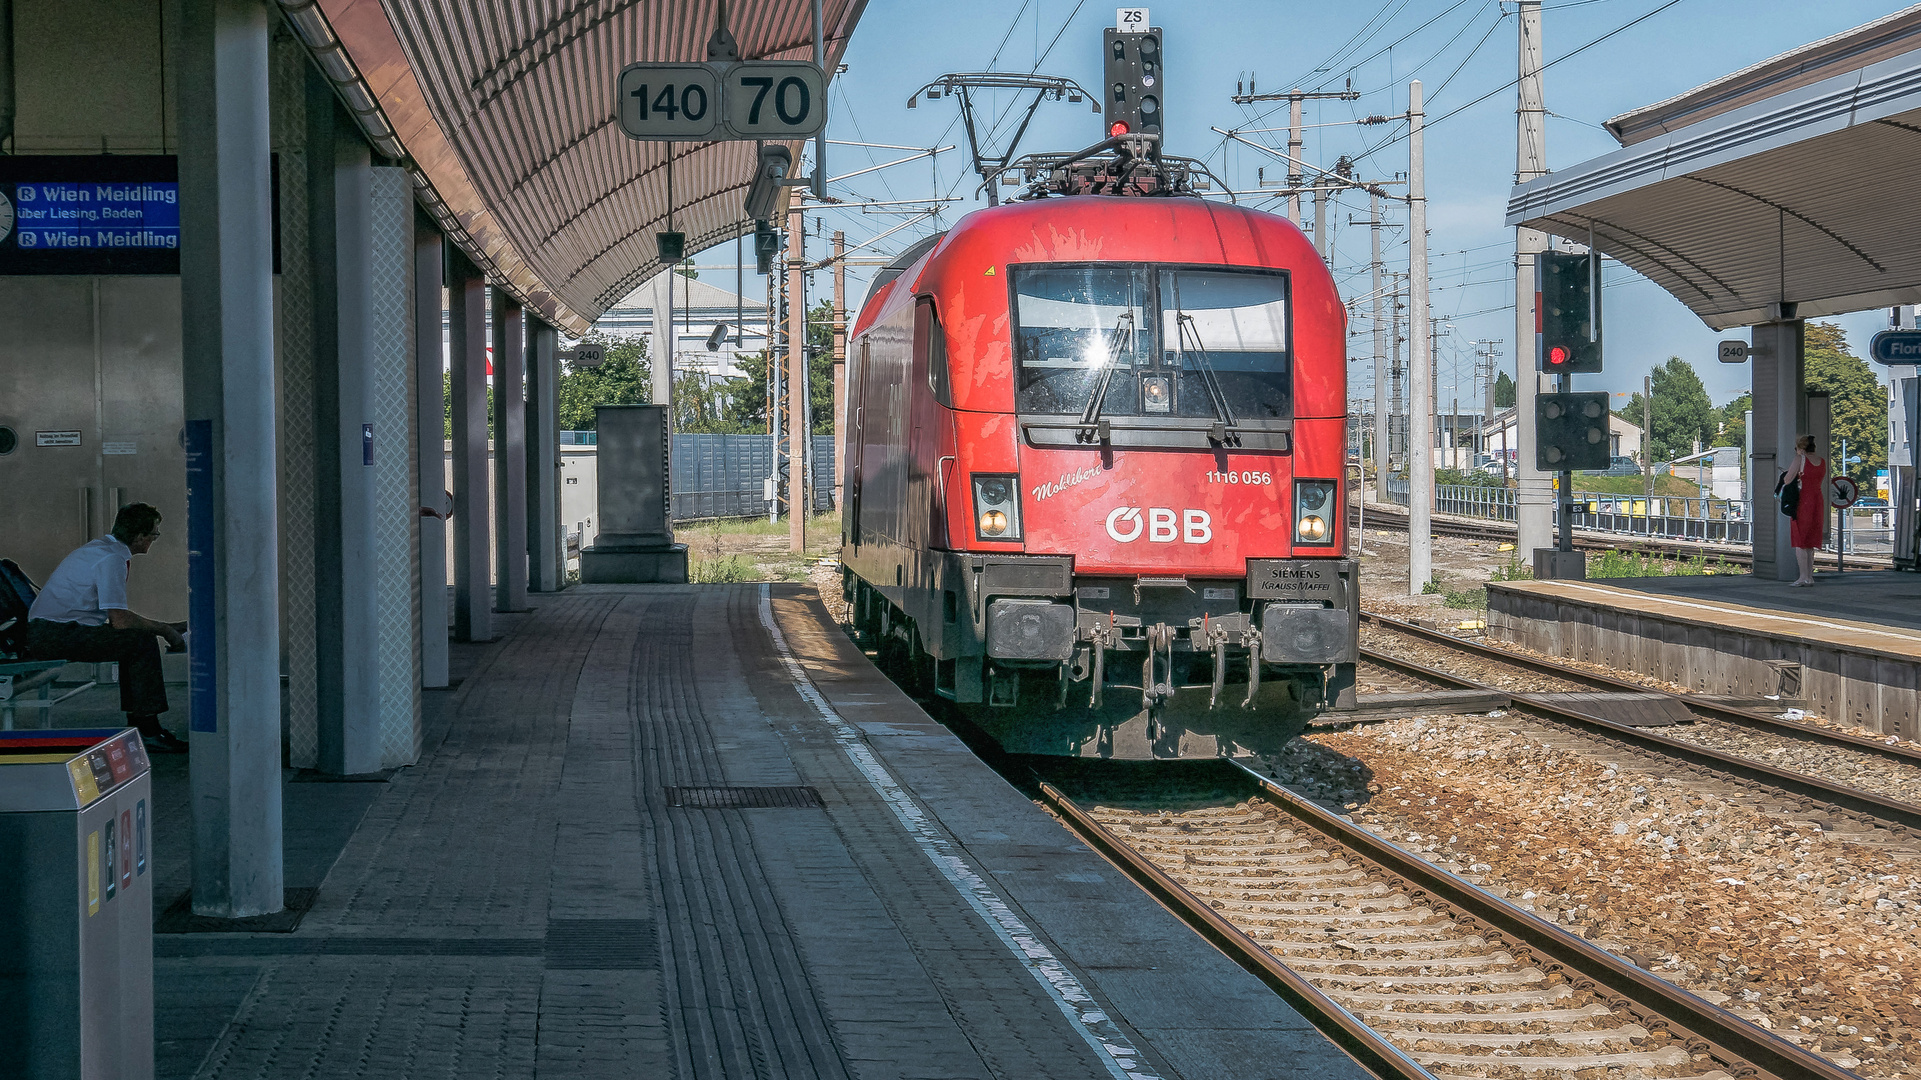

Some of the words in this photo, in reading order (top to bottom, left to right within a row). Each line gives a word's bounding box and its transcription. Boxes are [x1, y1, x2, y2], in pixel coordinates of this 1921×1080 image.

[1123, 11, 1142, 22] ZS
[630, 83, 708, 121] 140
[740, 76, 811, 126] 70
[43, 186, 91, 202] Wien
[96, 186, 177, 204] Meidling
[17, 207, 48, 219] über
[50, 207, 100, 222] Liesing,
[102, 207, 143, 219] Baden
[44, 231, 91, 247] Wien
[97, 231, 178, 249] Meidling
[761, 234, 772, 250] Z
[578, 350, 600, 360] 240
[1723, 347, 1744, 357] 240
[1205, 471, 1239, 485] 1116
[1241, 471, 1272, 485] 056
[1105, 506, 1213, 545] ÖBB
[1271, 569, 1321, 579] SIEMENS
